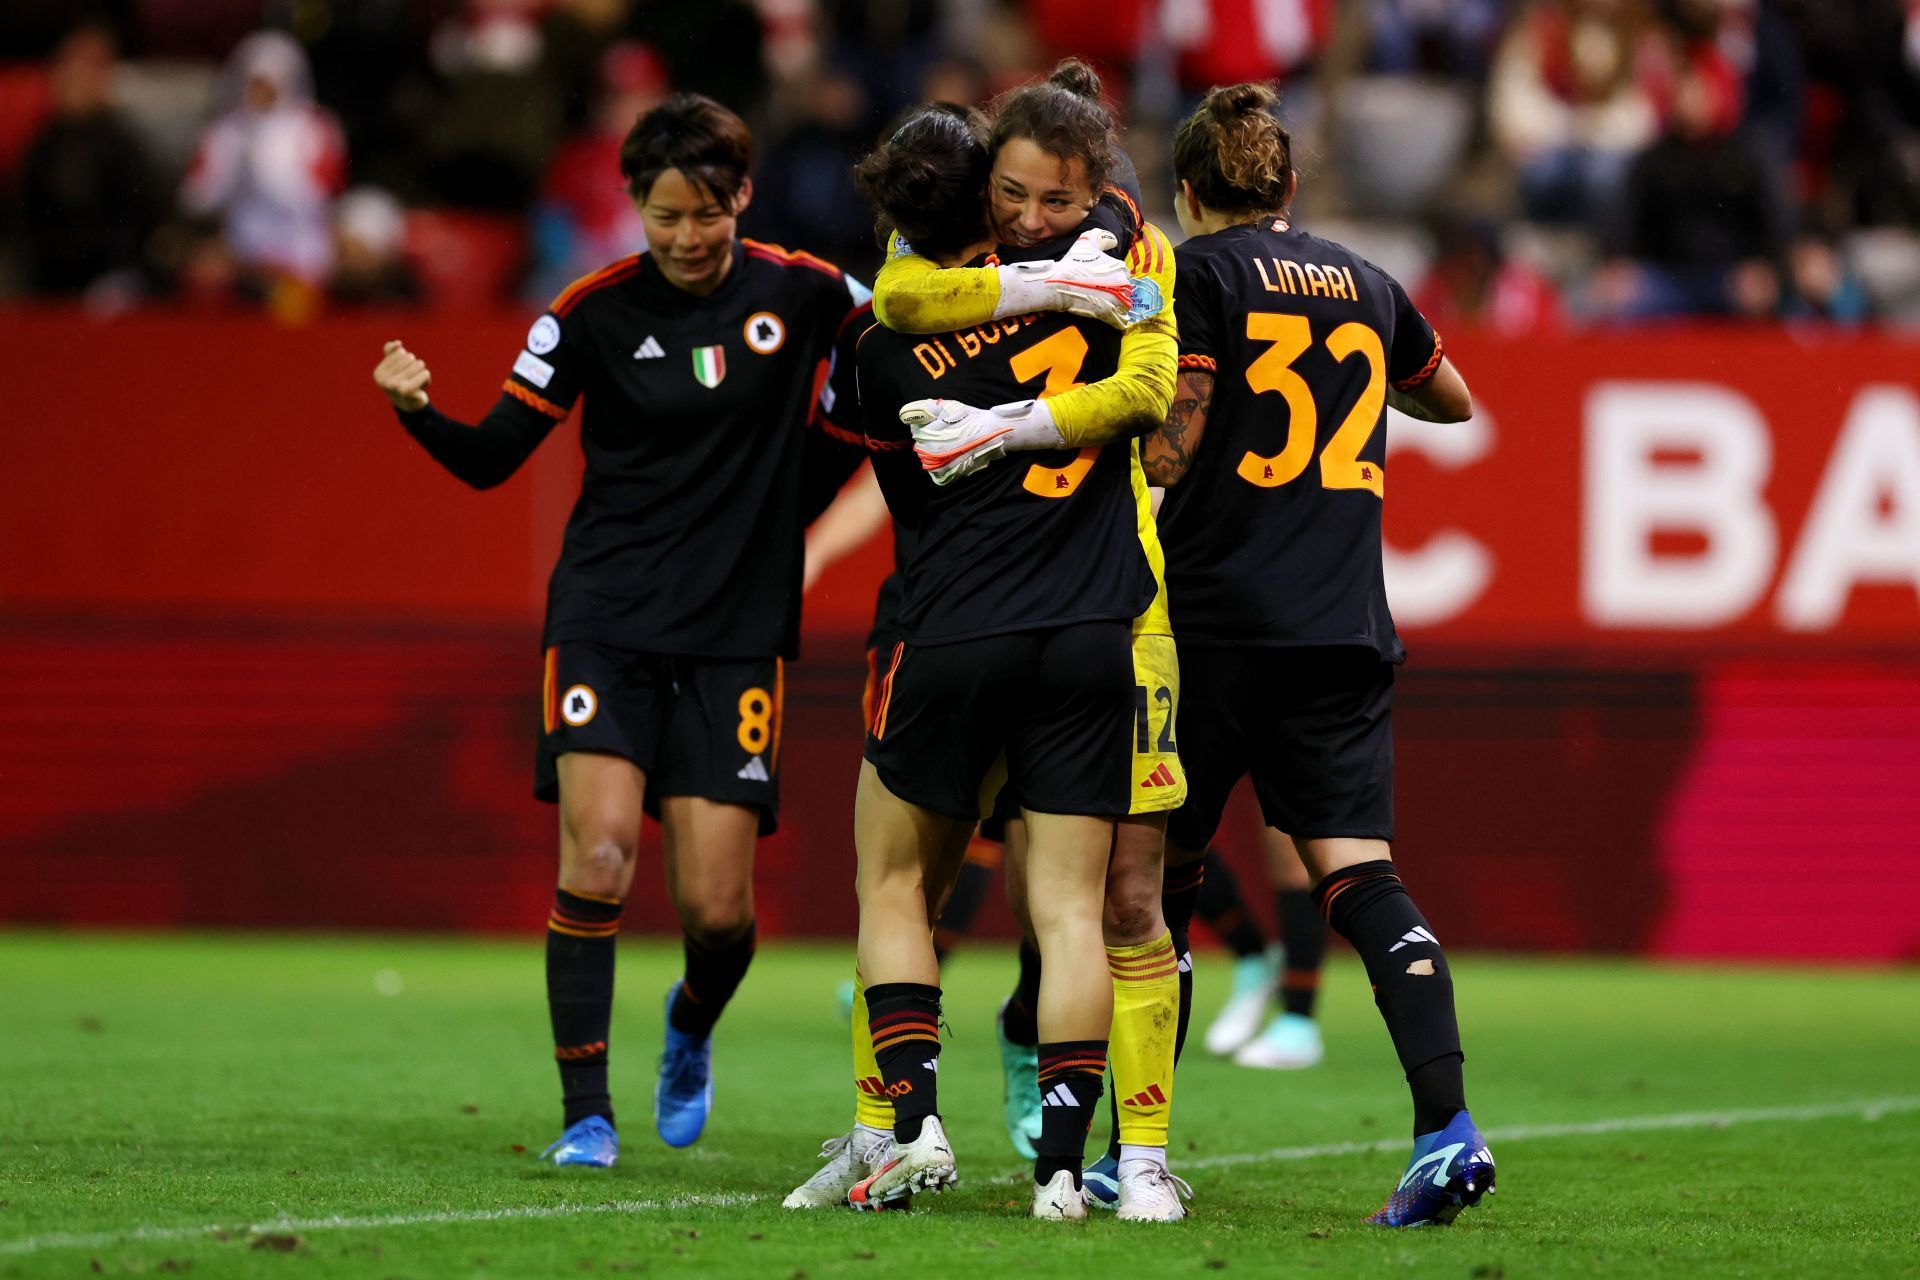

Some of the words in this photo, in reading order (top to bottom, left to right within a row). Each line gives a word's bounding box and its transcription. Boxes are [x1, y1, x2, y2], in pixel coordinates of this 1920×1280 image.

[1252, 257, 1359, 302] LINARI
[912, 336, 957, 380] DI
[1009, 325, 1103, 498] 3
[1236, 311, 1388, 500] 32
[737, 687, 773, 755] 8
[1136, 686, 1177, 753] 12
